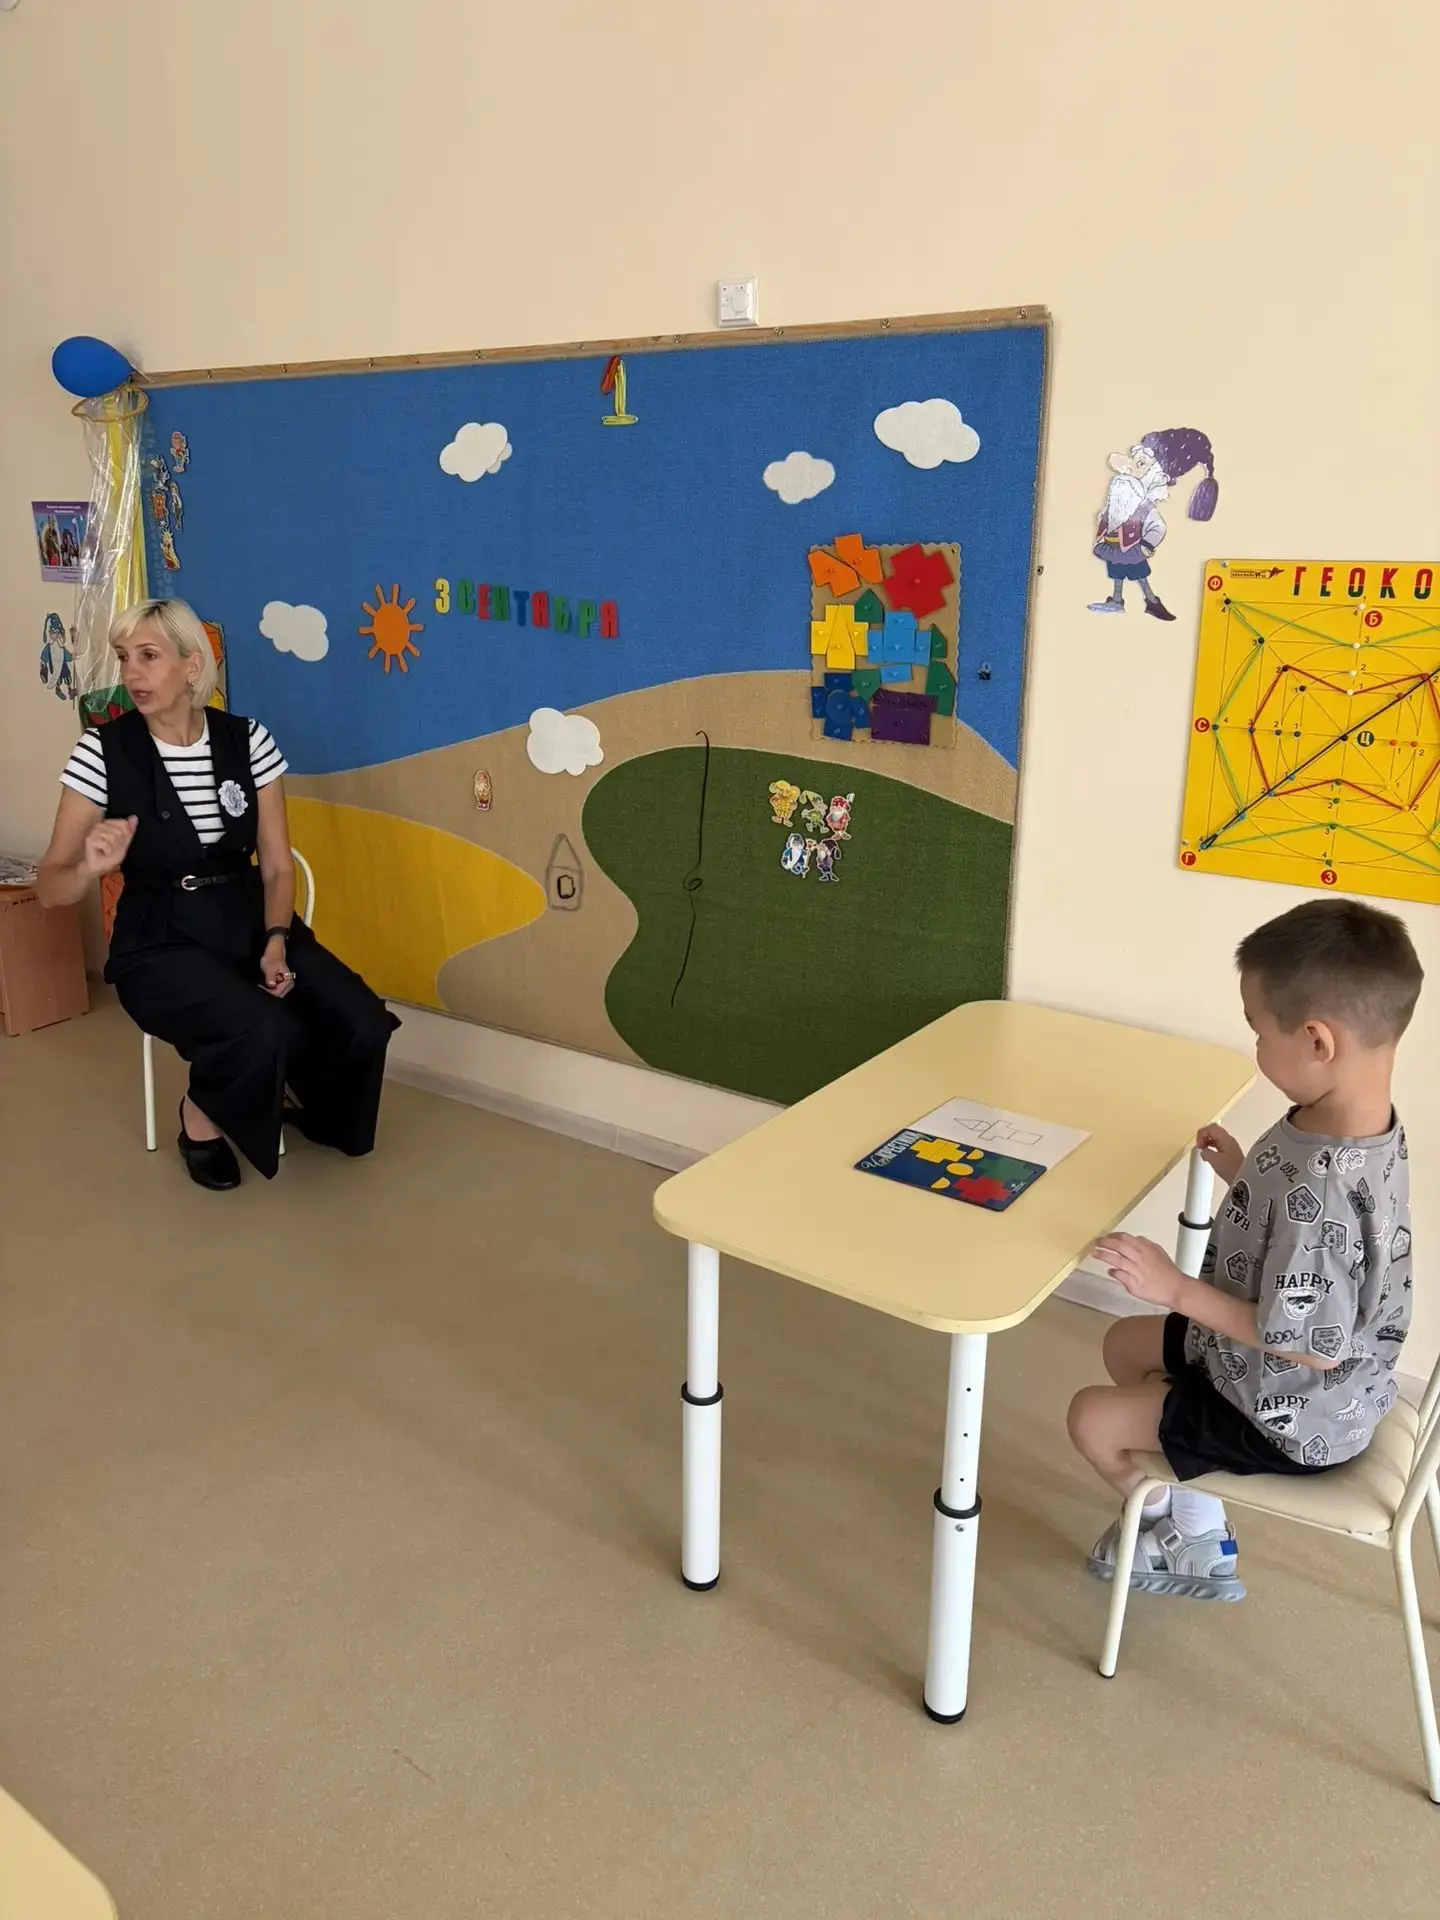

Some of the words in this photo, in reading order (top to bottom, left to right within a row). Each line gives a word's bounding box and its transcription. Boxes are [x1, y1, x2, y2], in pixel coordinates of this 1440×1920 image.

[1293, 566, 1434, 600] ГЕОКО
[434, 577, 451, 615] 3
[1369, 612, 1379, 626] Б
[1360, 732, 1371, 745] Ц
[1274, 1272, 1335, 1295] HAPPY
[1264, 1329, 1303, 1344] COOL
